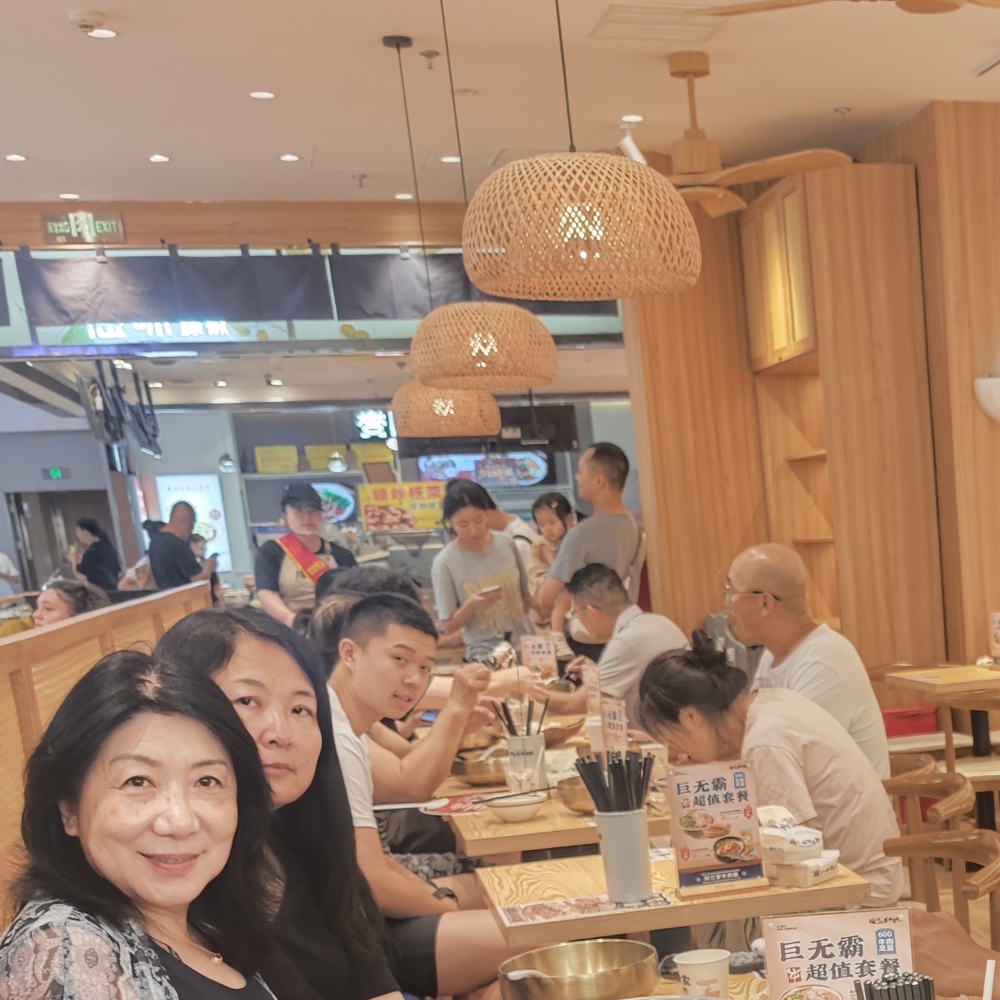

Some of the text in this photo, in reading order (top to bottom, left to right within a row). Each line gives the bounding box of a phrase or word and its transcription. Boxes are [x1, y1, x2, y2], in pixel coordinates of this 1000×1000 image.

[94, 220, 118, 233] EXIT
[677, 776, 728, 796] 巨无霸
[692, 790, 750, 808] 超值套餐
[877, 930, 893, 938] 60G
[779, 934, 864, 962] 巨无霸
[806, 957, 900, 982] 超值套餐
